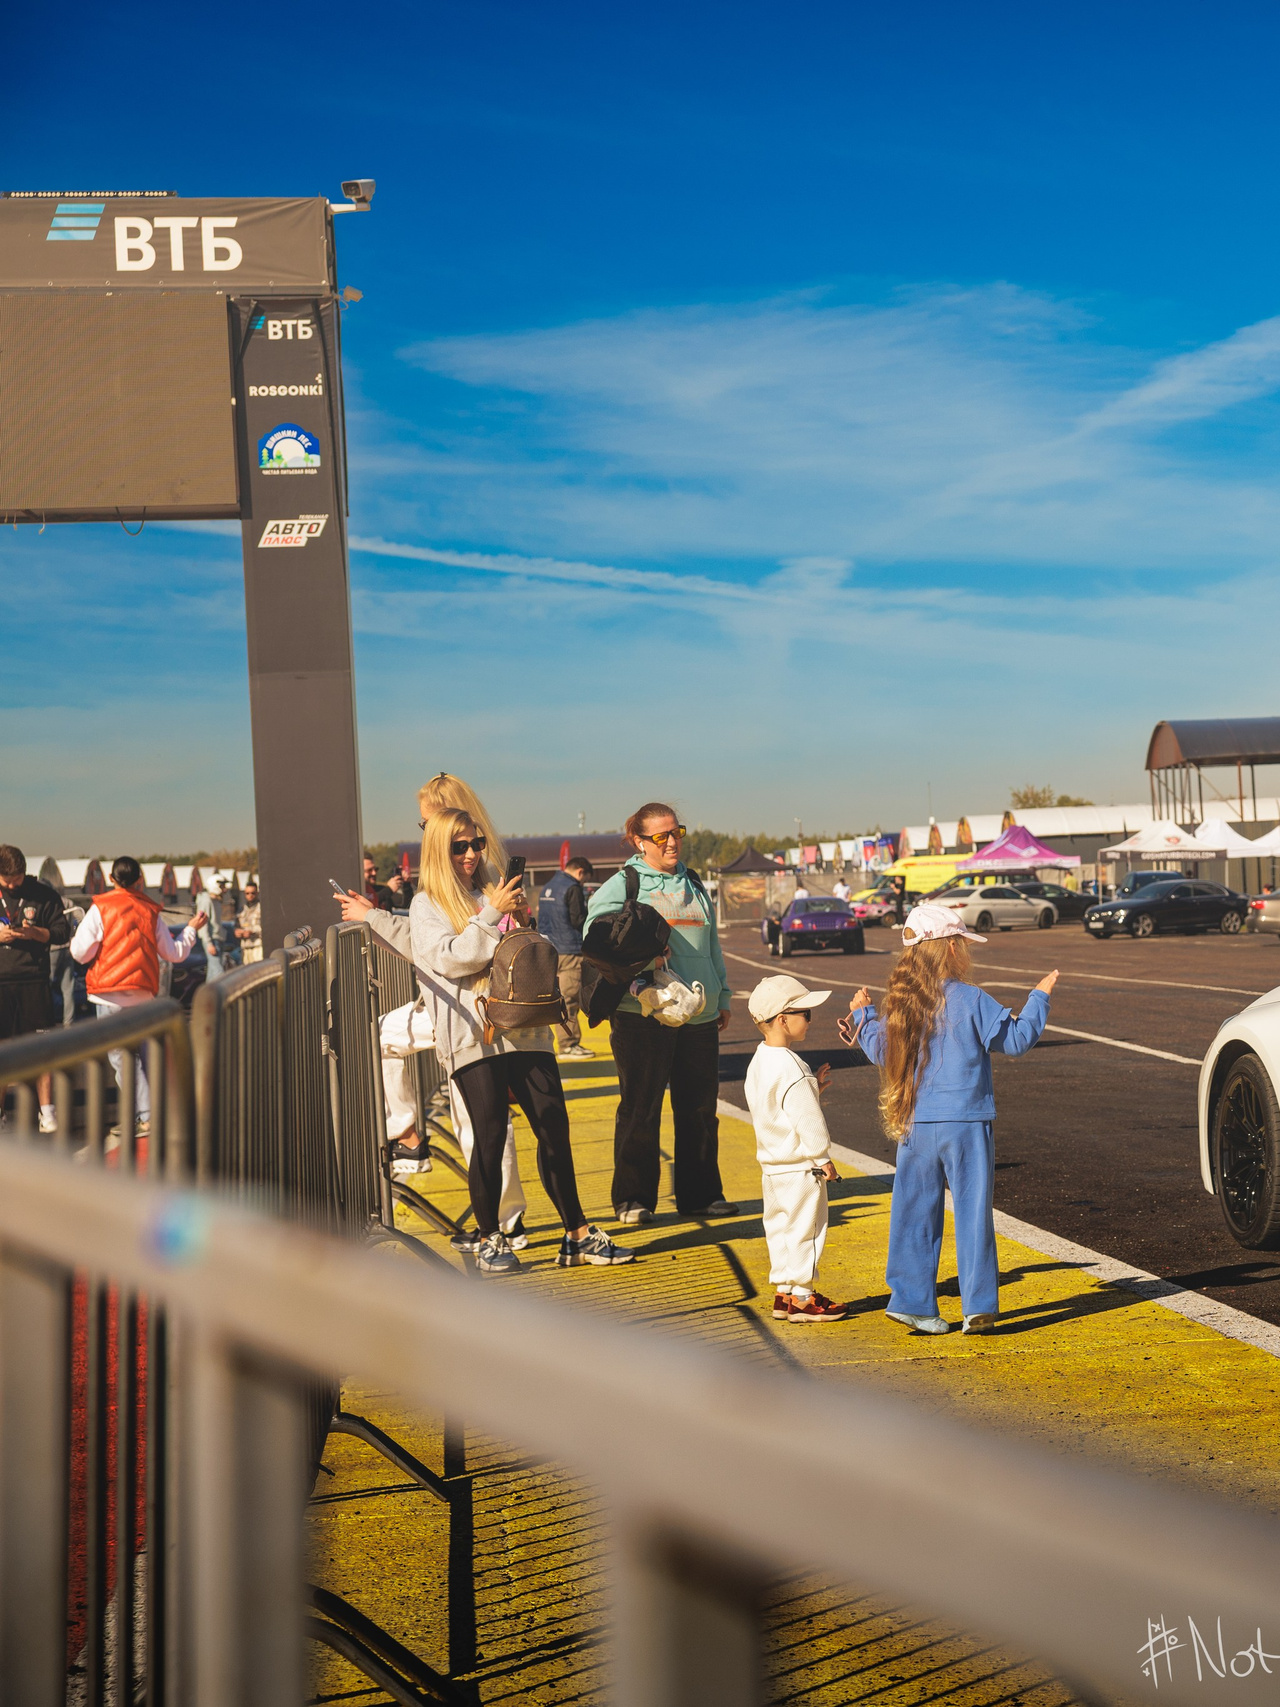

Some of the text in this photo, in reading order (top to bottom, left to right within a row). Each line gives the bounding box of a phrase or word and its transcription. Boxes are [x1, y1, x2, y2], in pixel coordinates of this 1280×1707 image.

[114, 216, 243, 272] ВТБ
[267, 319, 313, 340] ВТБ
[249, 380, 323, 396] ROSGONKI
[265, 430, 313, 449] ШИШКИН ЛЕС
[267, 522, 321, 535] АВТО
[262, 536, 302, 545] ПЛЮС
